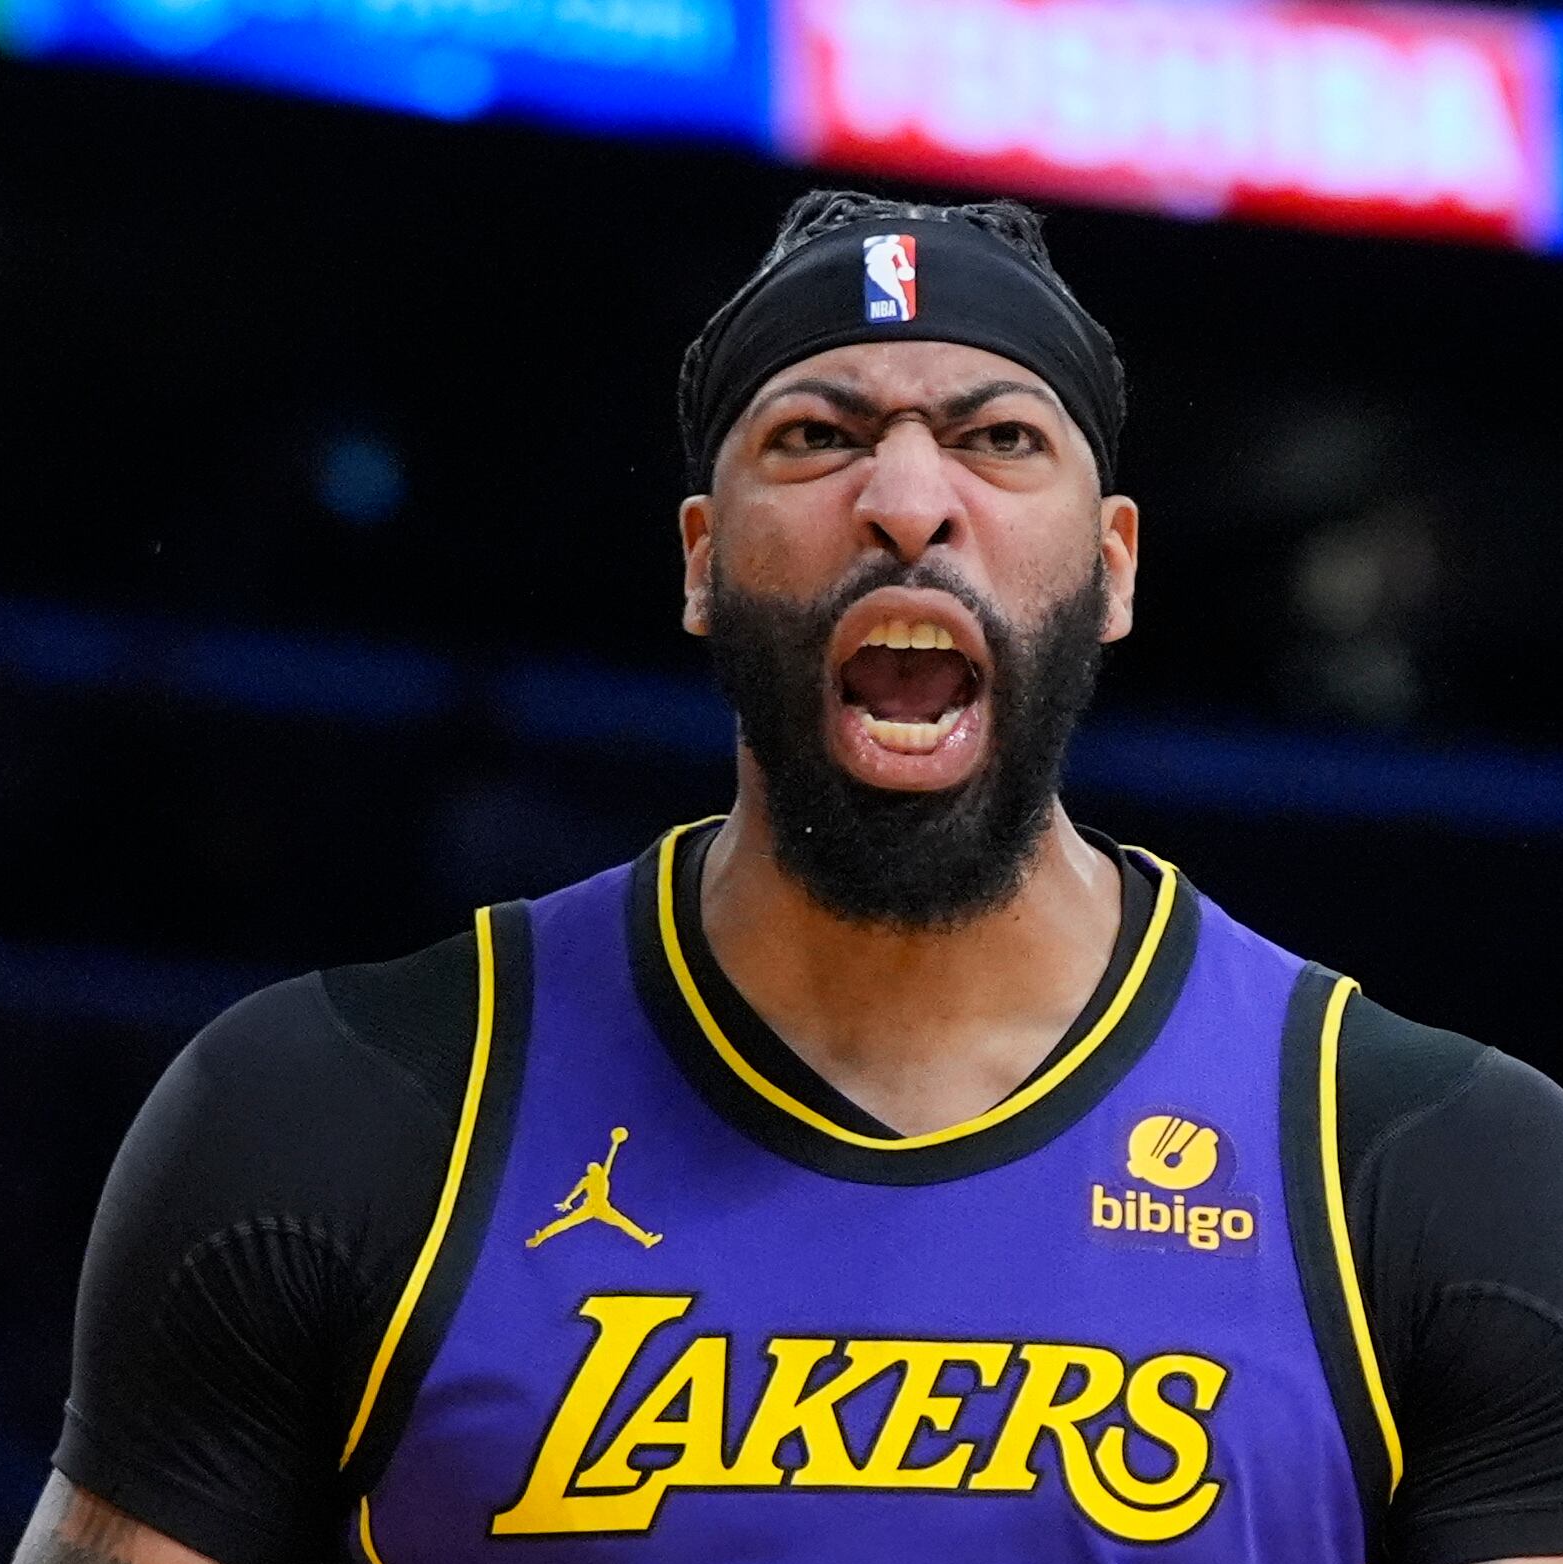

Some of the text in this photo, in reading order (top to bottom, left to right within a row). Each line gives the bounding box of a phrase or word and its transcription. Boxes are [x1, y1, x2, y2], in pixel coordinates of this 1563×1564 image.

[870, 300, 897, 319] NBA
[1092, 1184, 1255, 1250] bibigo
[488, 1293, 1229, 1546] LAKERS
